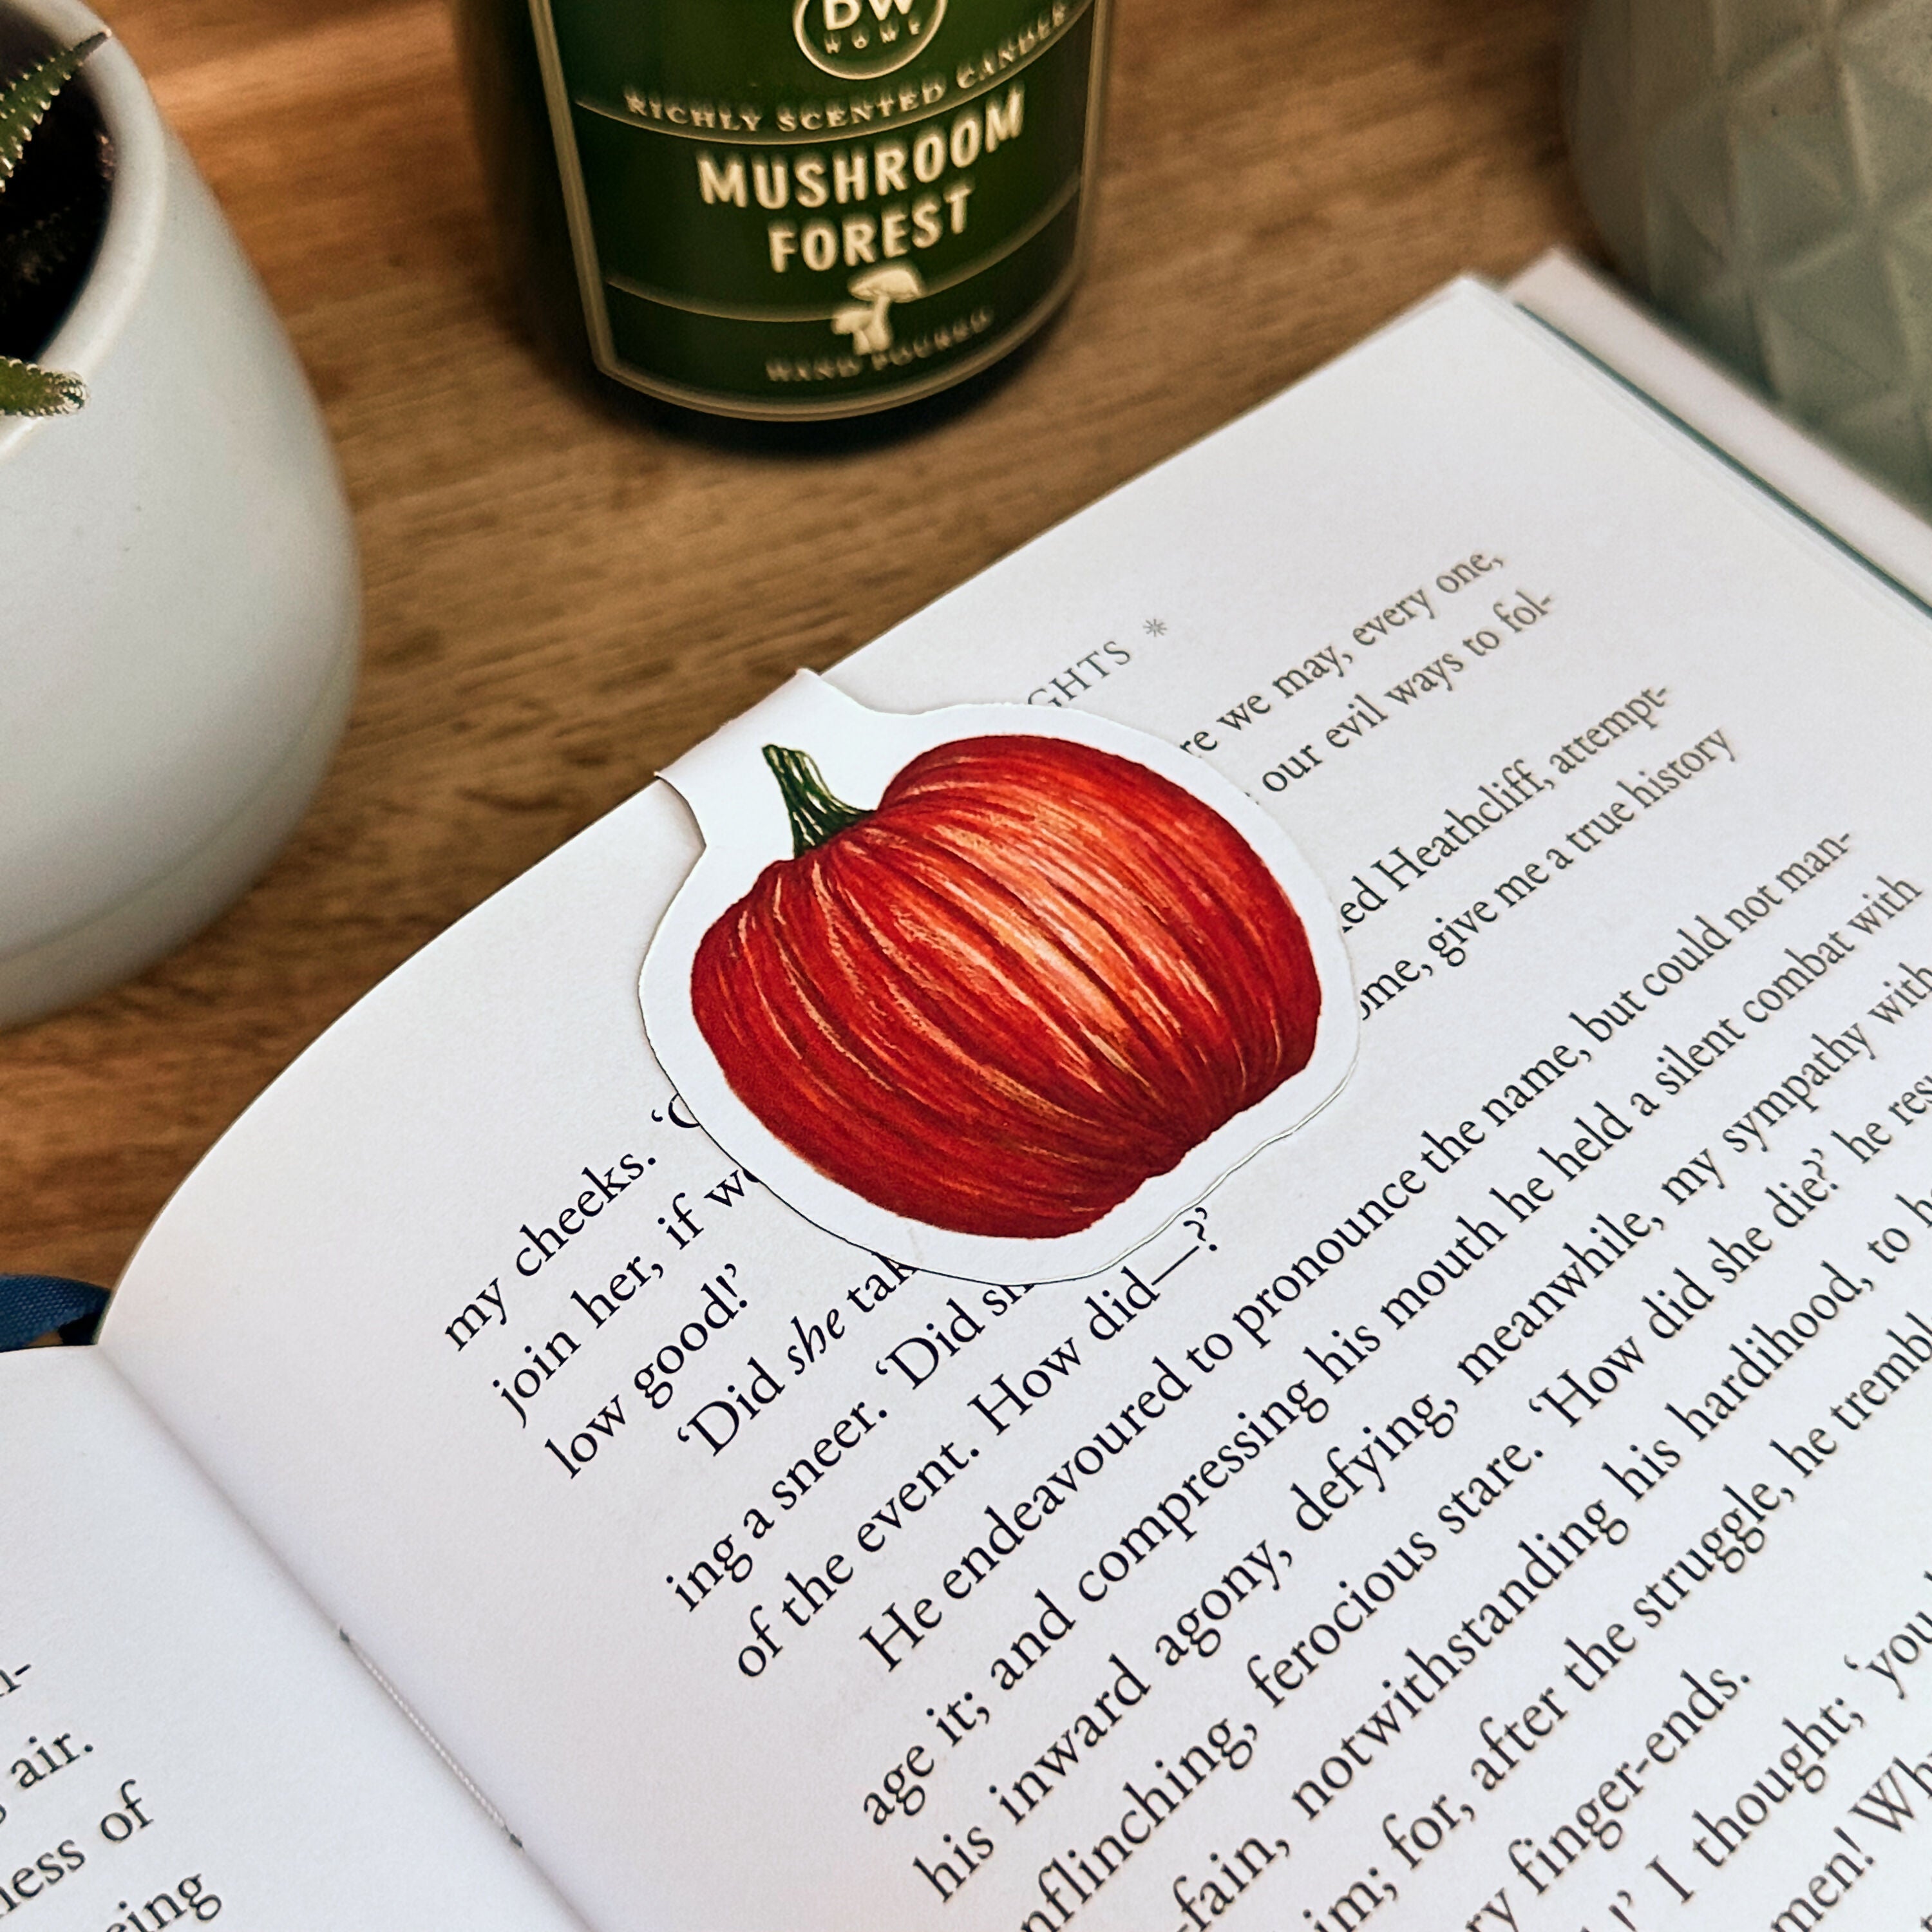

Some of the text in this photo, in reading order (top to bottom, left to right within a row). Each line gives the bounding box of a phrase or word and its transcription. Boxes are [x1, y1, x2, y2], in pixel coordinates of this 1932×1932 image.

[622, 85, 762, 132] RICHLY
[775, 73, 947, 132] SCENTED
[697, 82, 1025, 209] MUSHROOM
[768, 182, 974, 272] FOREST
[444, 1277, 507, 1352] my
[515, 1153, 657, 1277] cheeks.
[1215, 695, 1271, 731] we
[1271, 645, 1353, 699] may,
[1352, 589, 1435, 646] every
[1435, 554, 1504, 594] one,
[492, 1331, 582, 1430] join
[569, 1255, 664, 1330] her,
[657, 1191, 705, 1251] if
[1262, 744, 1323, 792] our
[1325, 694, 1389, 748] evil
[1383, 653, 1464, 705] ways
[1462, 630, 1501, 657] to
[1493, 590, 1551, 633] fol-
[665, 1533, 753, 1613] ing
[743, 1508, 775, 1540] a
[771, 1401, 888, 1511] sneer.
[1427, 901, 1499, 968] give
[1493, 863, 1550, 909] me
[1546, 848, 1575, 870] a
[1565, 798, 1634, 853] true
[1616, 729, 1736, 809] history
[787, 1308, 846, 1376] she
[1340, 875, 1389, 934] ed
[1370, 758, 1556, 893] Heathcliff,
[1549, 688, 1667, 775] attempt-
[544, 1394, 626, 1480] low
[858, 833, 1850, 1673] He endeavoured to pronounce the name, but could not man-
[863, 875, 1922, 1826] age it; and compressing his mouth he held a silent combat with
[912, 1826, 994, 1904] his
[989, 1653, 1152, 1826] inward
[1155, 1539, 1293, 1667] agony,
[1289, 1393, 1459, 1532] defying,
[1456, 1213, 1665, 1387] meanwhile,
[1660, 1148, 1726, 1206] my
[1722, 1022, 1877, 1153] sympathy
[1246, 1531, 1437, 1709] ferocious
[1437, 1444, 1544, 1535] stare.
[1641, 1267, 1716, 1340] did
[1707, 1227, 1774, 1284] she
[1830, 1122, 1893, 1164] he
[737, 1604, 784, 1678] of
[781, 1554, 854, 1627] the
[857, 1441, 980, 1553] event.
[966, 1336, 1082, 1437] How
[1291, 1499, 1630, 1822] notwithstanding
[1600, 1439, 1681, 1502] his
[1664, 1260, 1875, 1443] hardihood,
[1866, 1227, 1911, 1264] to
[1382, 1794, 1475, 1871] for,
[1470, 1687, 1569, 1792] after
[1563, 1623, 1637, 1692] the
[1633, 1482, 1797, 1629] struggle,
[1768, 1428, 1838, 1479] he
[10, 1732, 94, 1790] air.
[99, 1778, 155, 1844] of
[1508, 1669, 1751, 1896] finger-ends.
[1645, 1855, 1694, 1904] I
[1691, 1697, 1865, 1869] thought;
